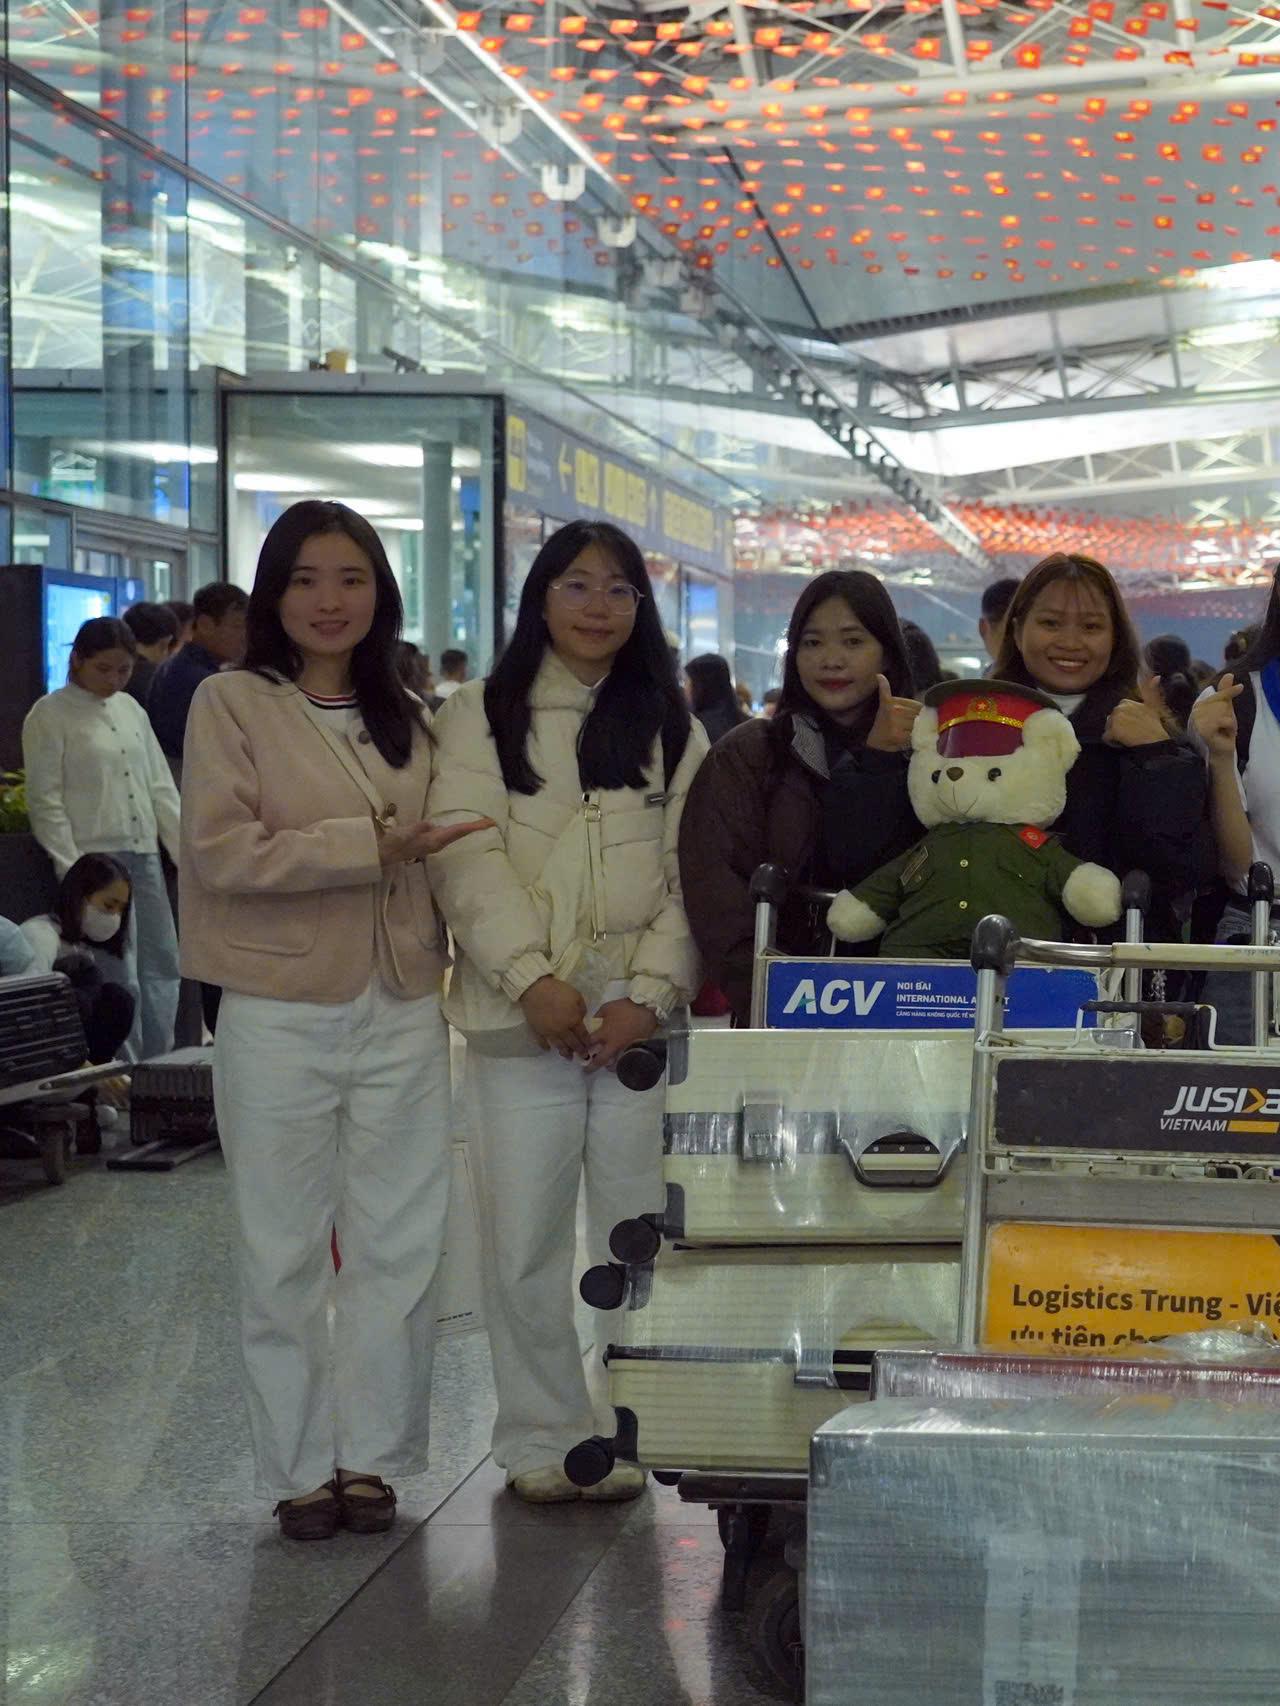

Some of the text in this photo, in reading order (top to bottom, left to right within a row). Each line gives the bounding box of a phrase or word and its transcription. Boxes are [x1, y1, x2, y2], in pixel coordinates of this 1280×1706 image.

[782, 978, 886, 1016] ACV
[896, 994, 969, 1004] INTERNATIONAL
[1159, 1118, 1227, 1132] VIETNAM
[1012, 1284, 1134, 1315] Logistics
[1141, 1289, 1223, 1321] Trung
